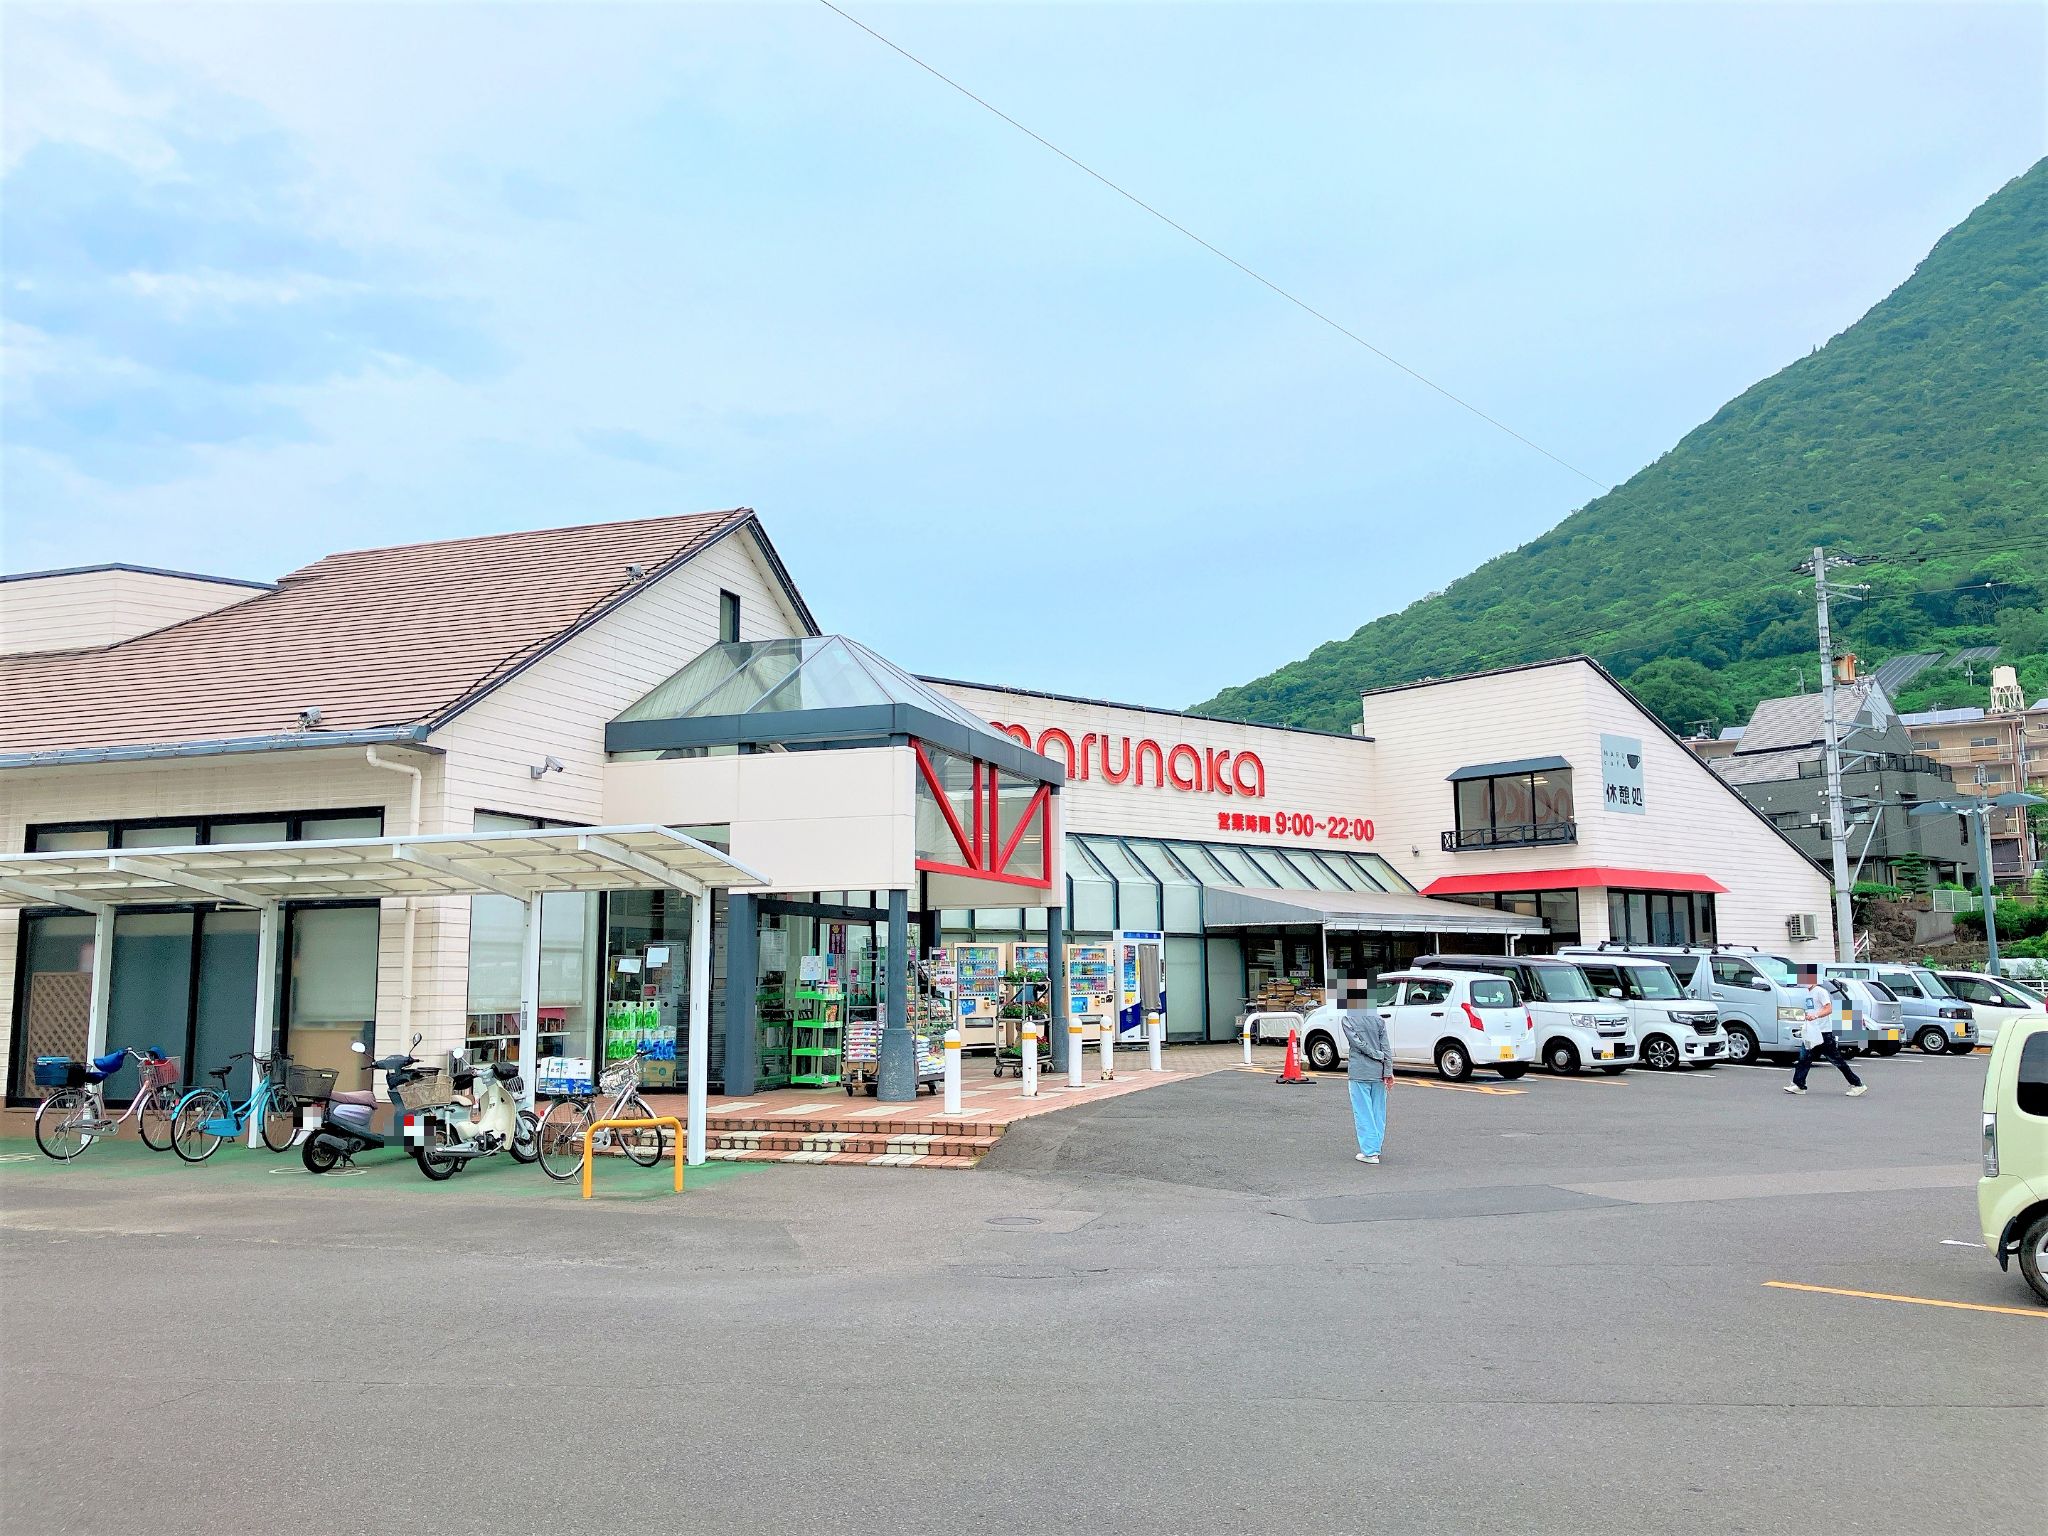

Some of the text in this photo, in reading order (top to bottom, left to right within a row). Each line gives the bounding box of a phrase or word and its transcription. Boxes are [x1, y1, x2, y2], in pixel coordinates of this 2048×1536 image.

[1606, 783, 1643, 807] 休憩処
[1217, 811, 1271, 834] 営業時間
